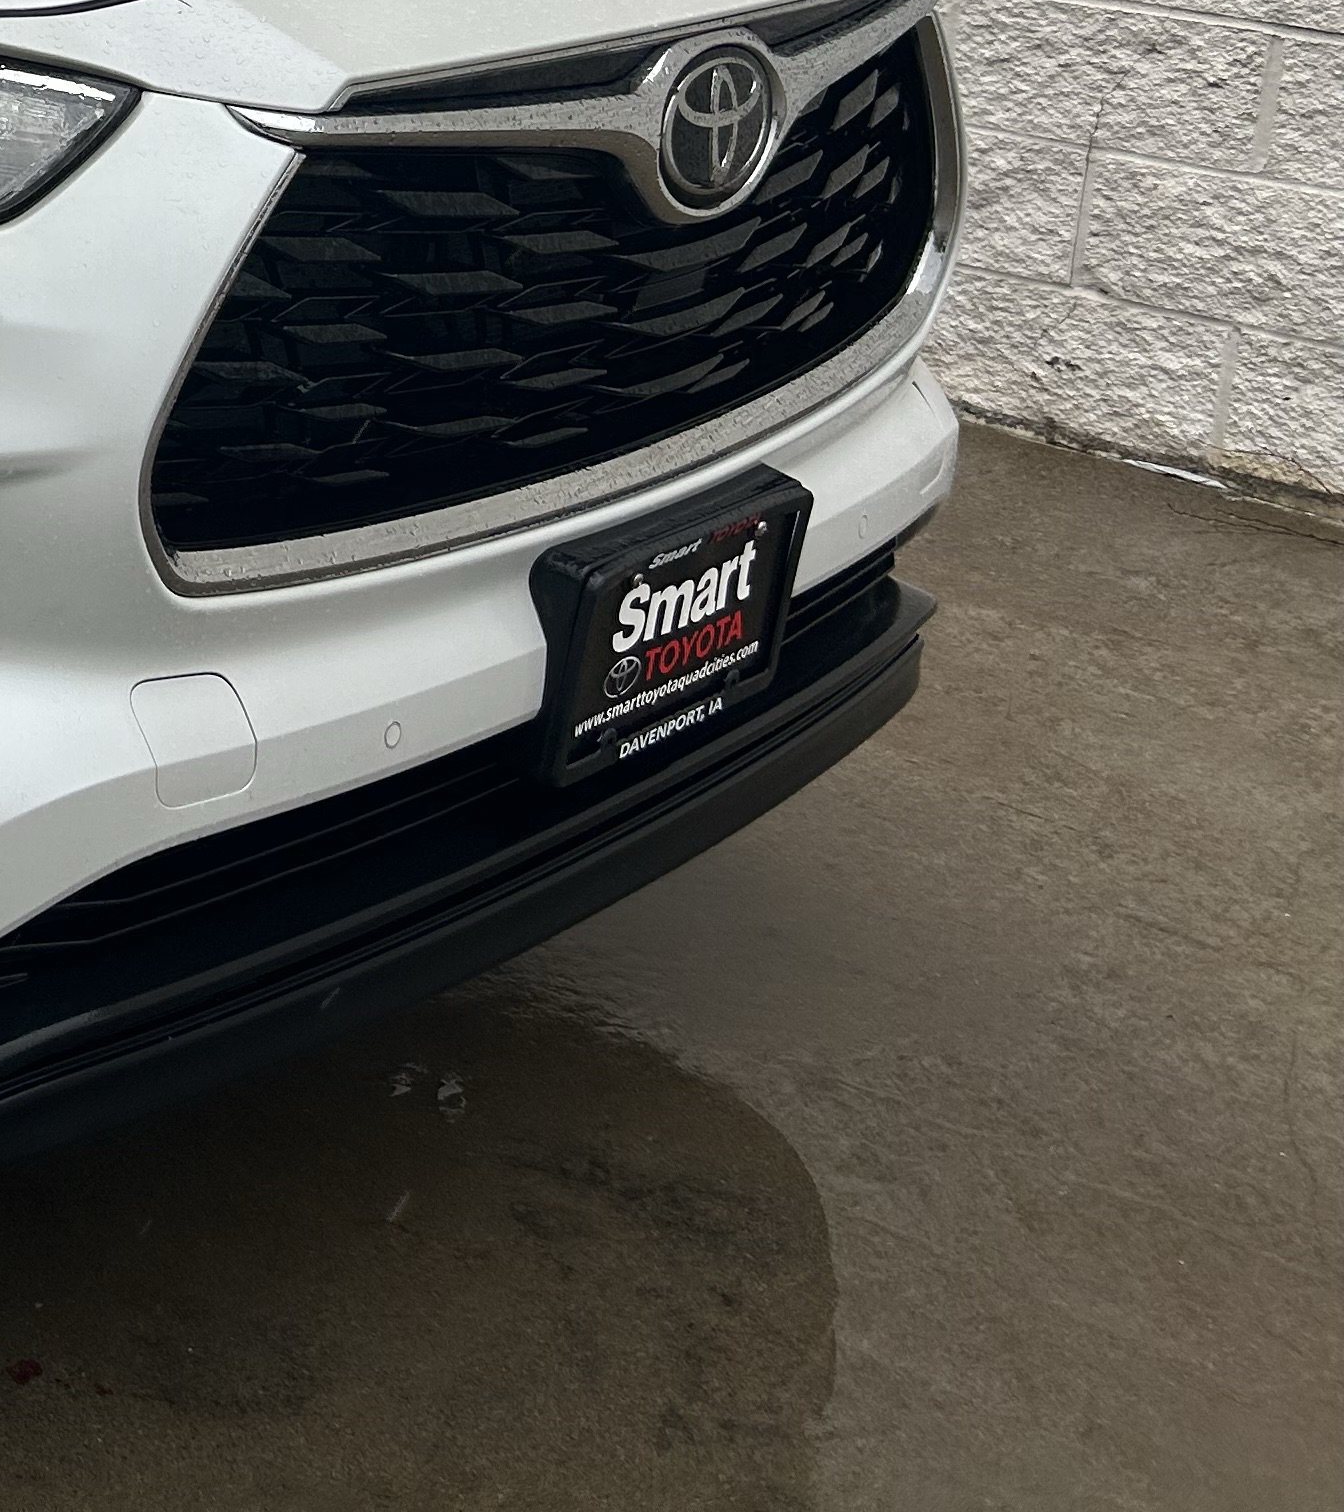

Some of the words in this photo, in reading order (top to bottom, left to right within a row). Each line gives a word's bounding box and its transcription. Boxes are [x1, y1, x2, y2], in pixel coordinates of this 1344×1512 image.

[648, 537, 703, 569] Smart
[612, 539, 757, 653] Smart
[644, 610, 744, 681] TOYOTA
[574, 640, 760, 738] www.smarttoyotaquadcities.com
[618, 704, 706, 759] DAVENPORT,
[707, 696, 724, 717] IA
